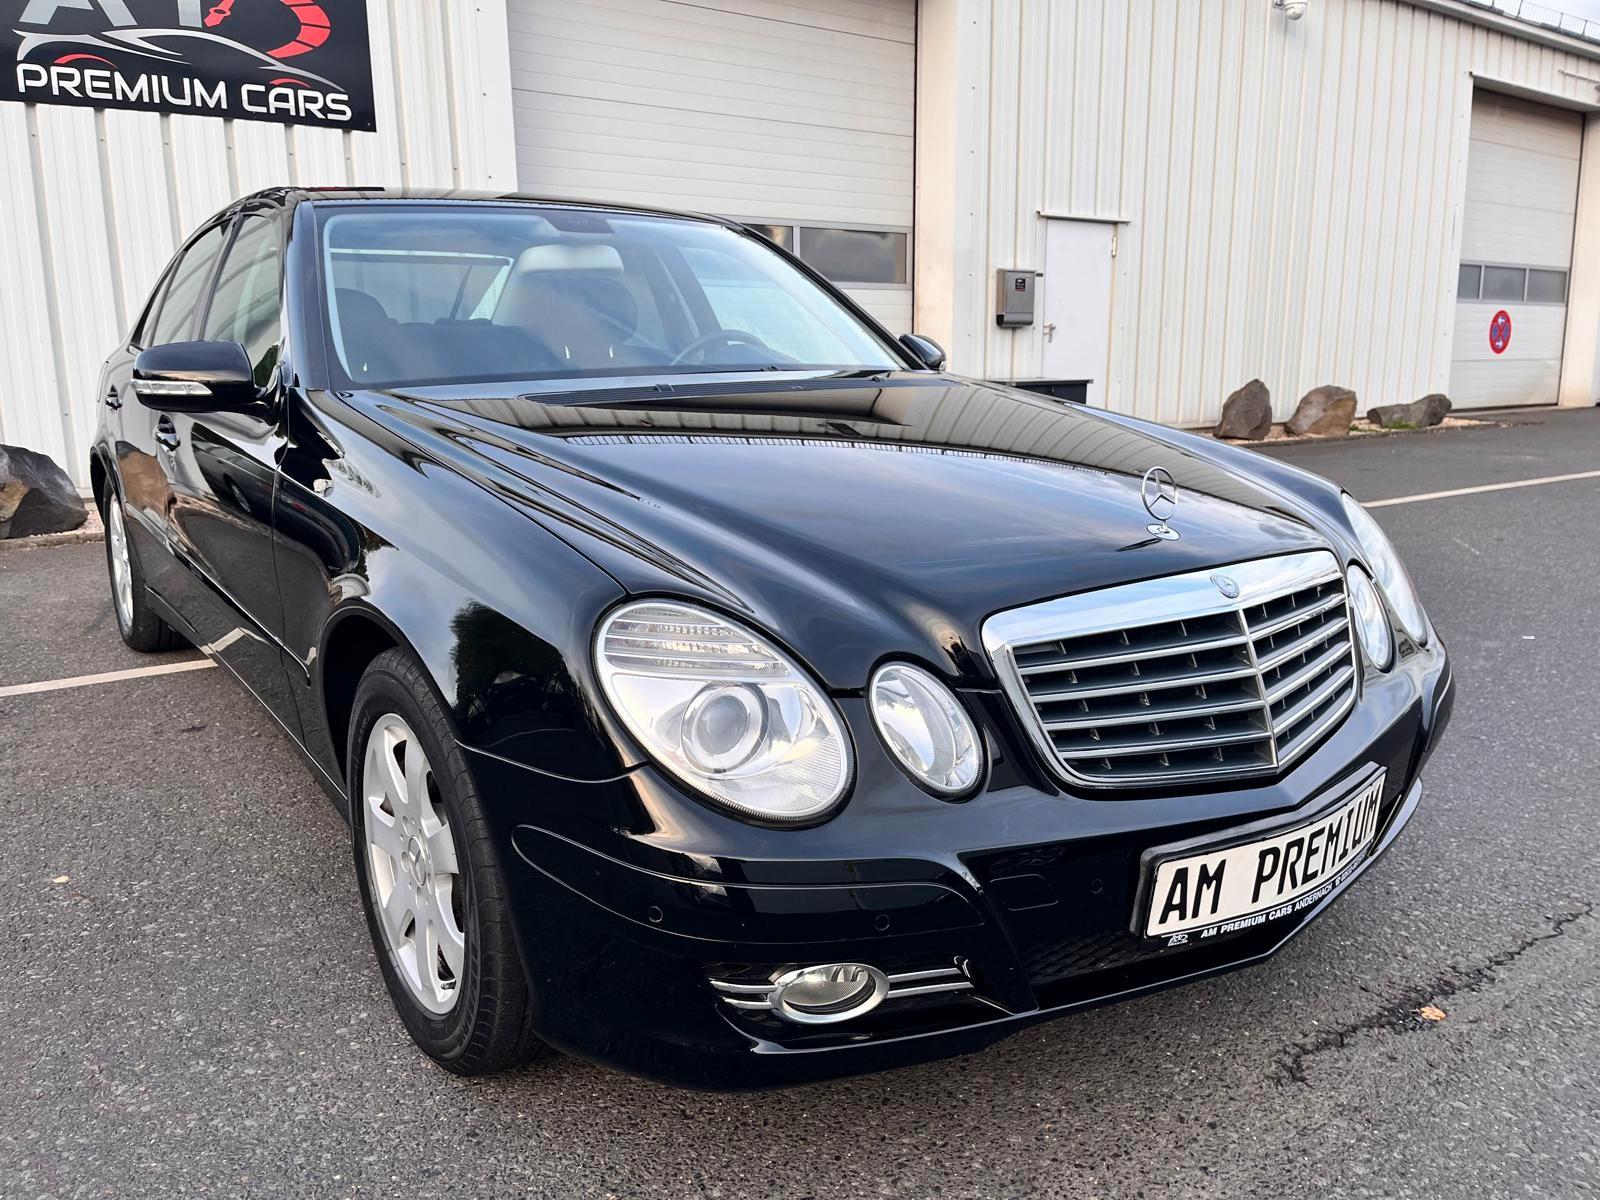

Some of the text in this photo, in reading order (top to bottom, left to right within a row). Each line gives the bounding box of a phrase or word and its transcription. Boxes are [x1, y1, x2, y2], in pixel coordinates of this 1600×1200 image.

[16, 63, 353, 122] PREMIUM CARS
[1158, 782, 1381, 924] AM PREMIUM
[1200, 883, 1333, 938] AM PREMIUM CARS ANDERNACH
